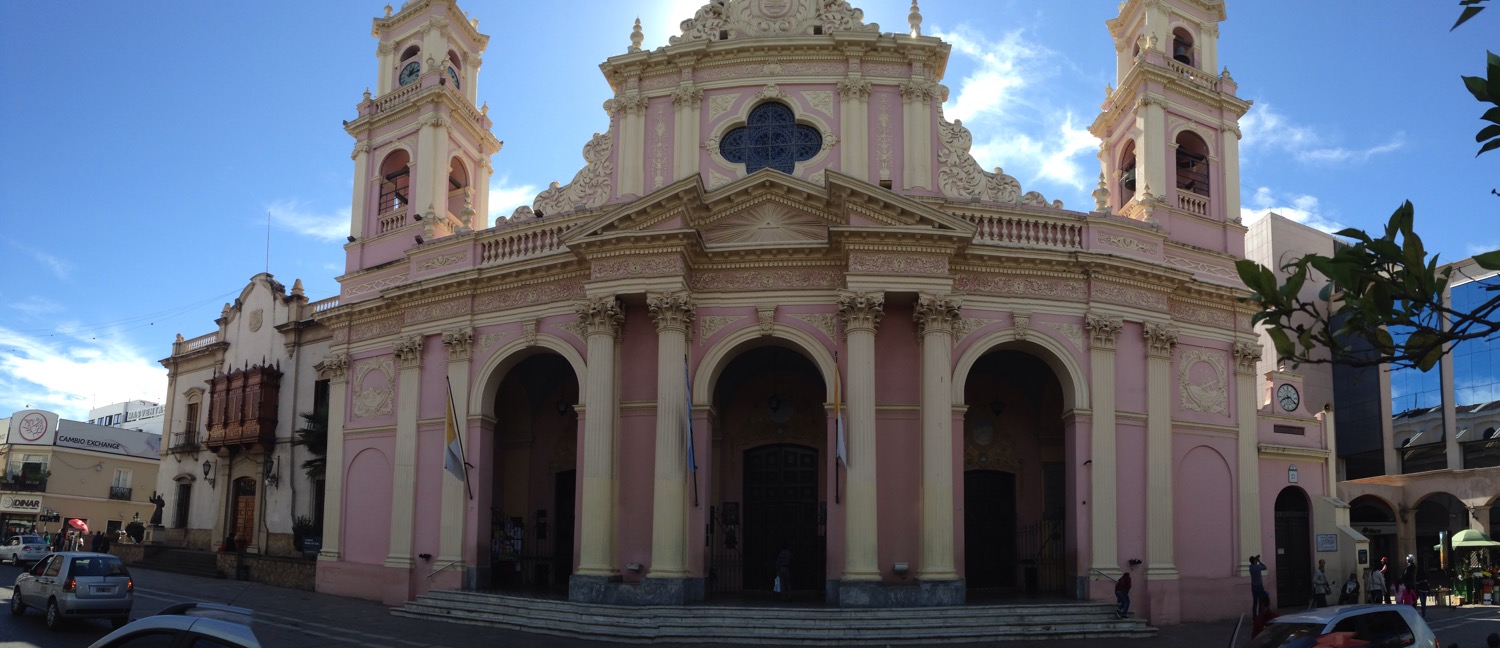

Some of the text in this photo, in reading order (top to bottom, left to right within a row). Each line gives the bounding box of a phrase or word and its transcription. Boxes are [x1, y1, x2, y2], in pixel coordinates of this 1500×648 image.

[59, 435, 120, 450] CAMBIO EXCHANGE
[14, 499, 40, 508] DINAR
